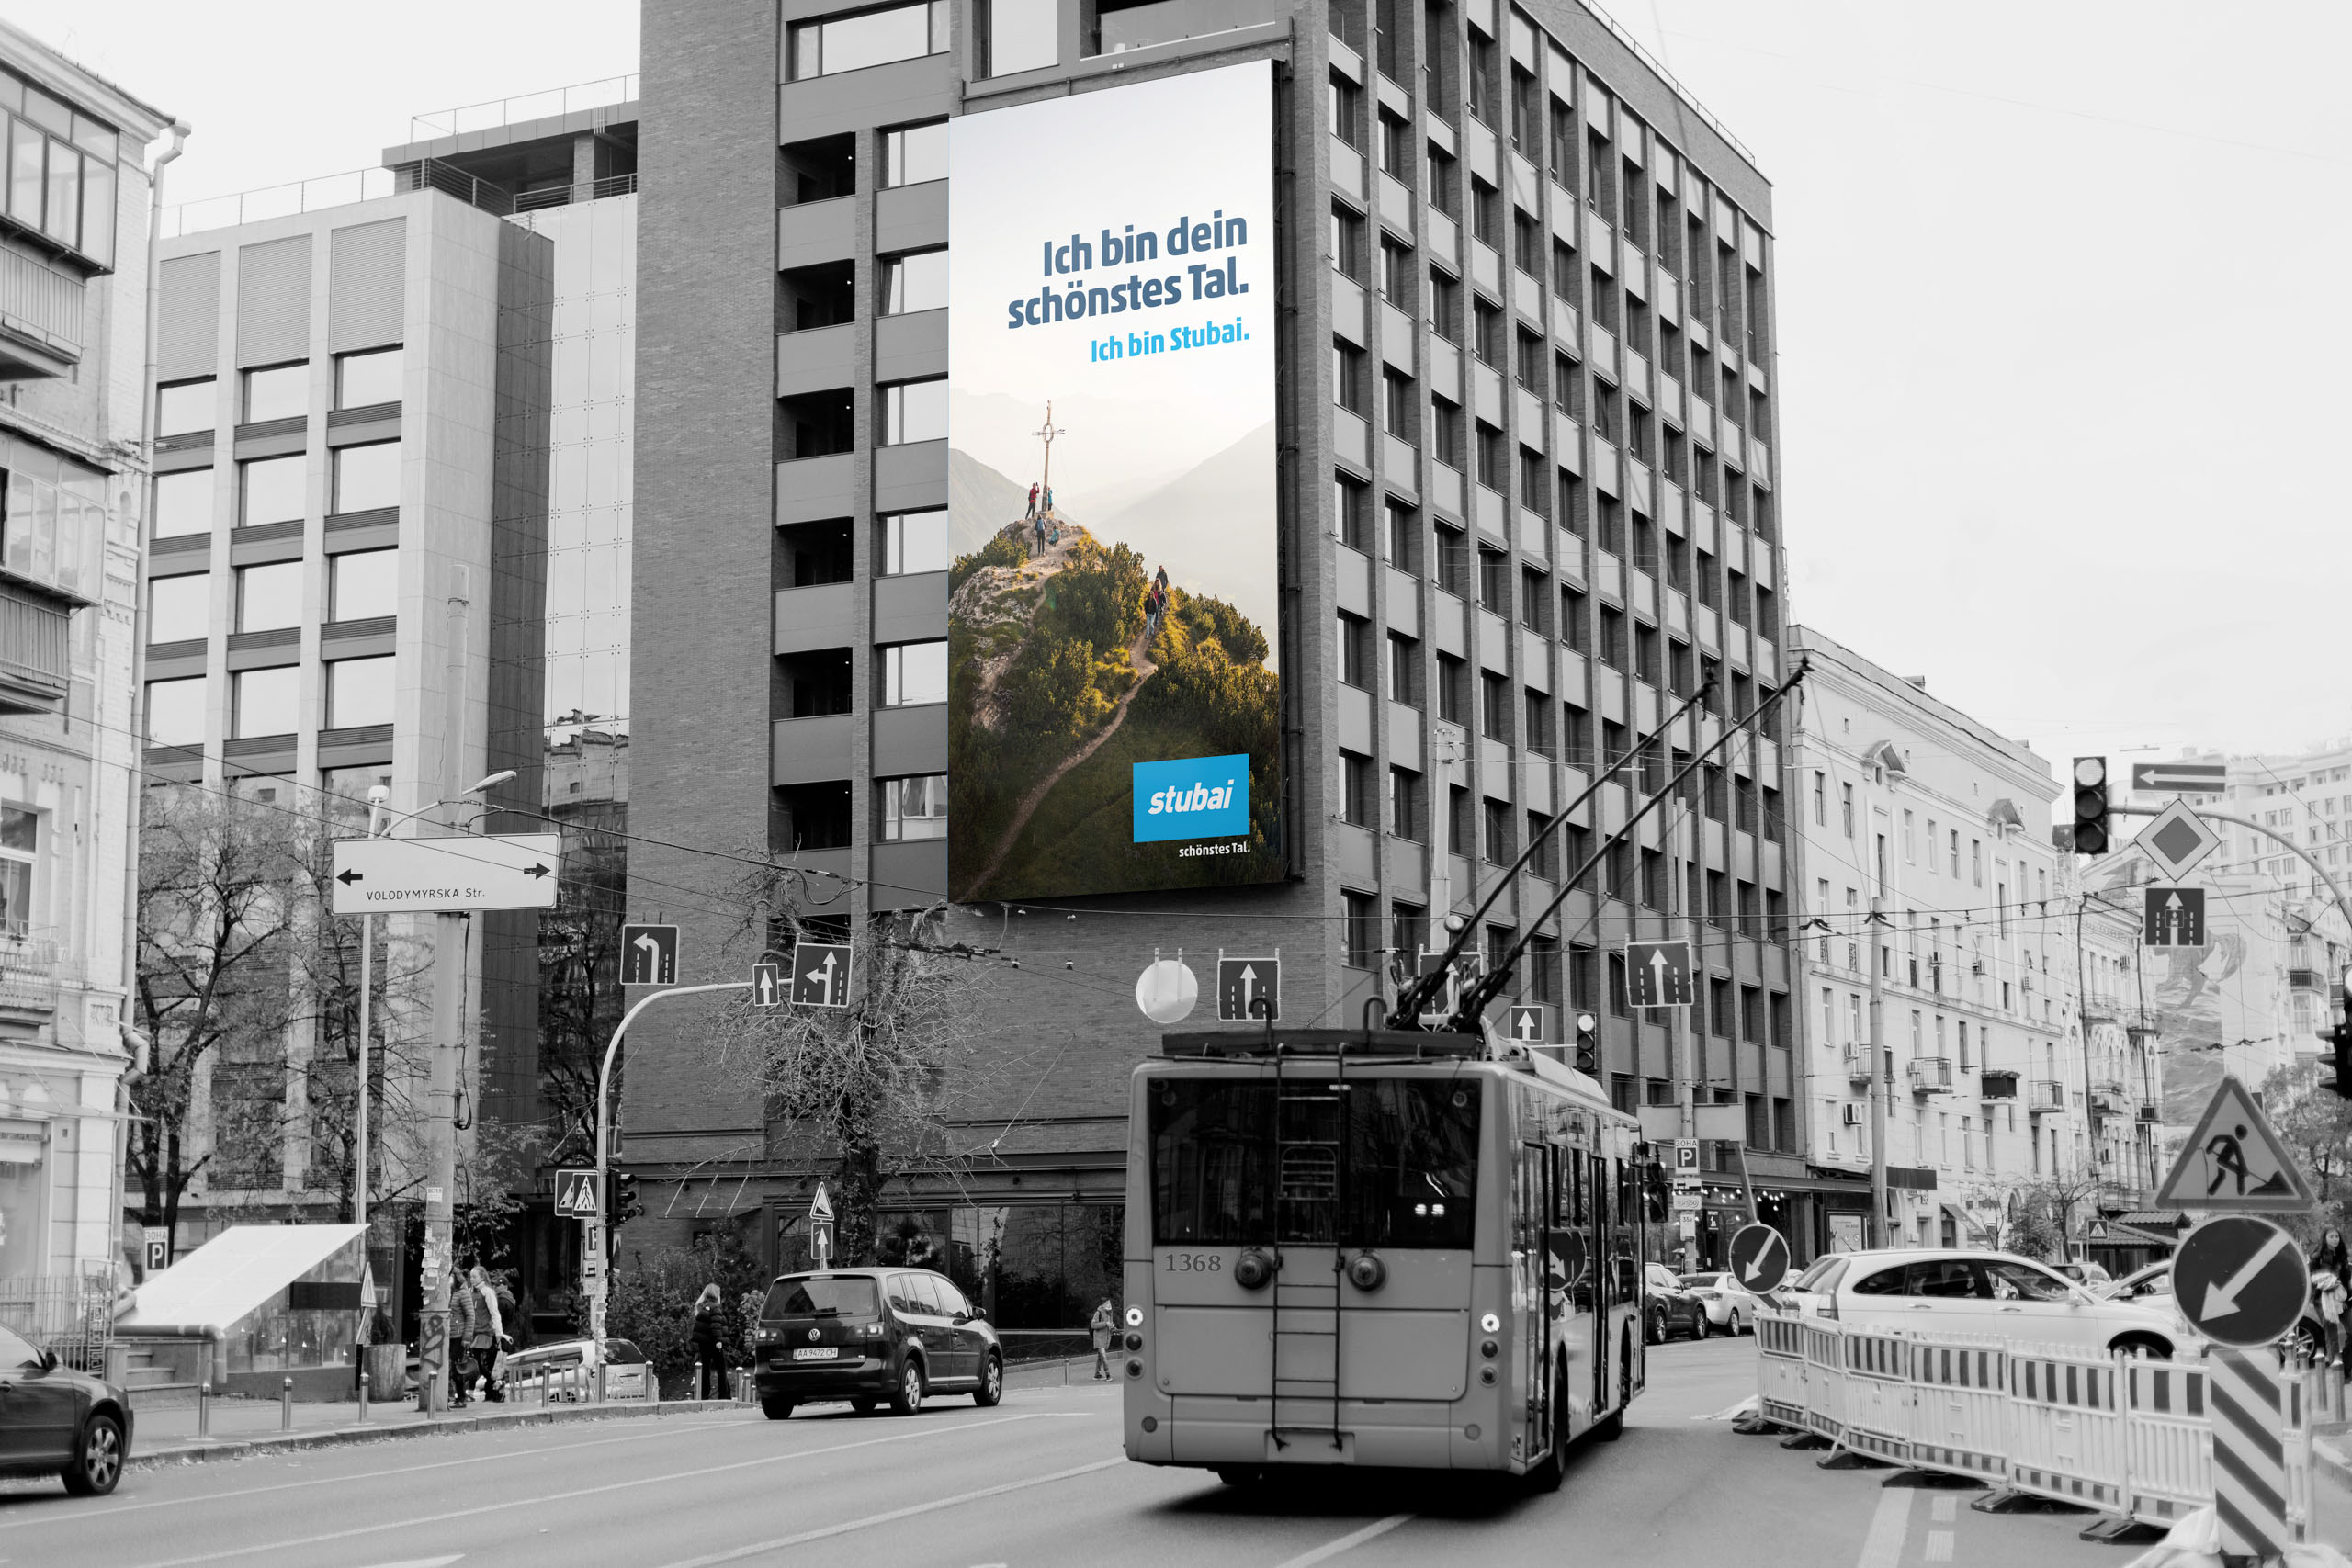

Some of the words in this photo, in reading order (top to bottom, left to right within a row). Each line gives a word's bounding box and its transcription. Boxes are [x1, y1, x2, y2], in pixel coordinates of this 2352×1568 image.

[1044, 234, 1092, 276] Ich
[1102, 224, 1158, 267] bin
[1166, 209, 1248, 256] dein
[1008, 275, 1182, 329] schönstes
[1187, 256, 1250, 301] Tal.
[1091, 335, 1123, 363] Ich
[1128, 330, 1165, 357] bin
[1170, 317, 1250, 352] Stubai.
[1148, 779, 1235, 815] stubai
[1179, 844, 1230, 857] schönstes
[1231, 841, 1250, 853] Tal.
[367, 888, 459, 901] VOLODYMYRSKA
[465, 887, 485, 897] Str.
[1680, 1149, 1693, 1167] P
[152, 1244, 164, 1269] P
[1165, 1253, 1222, 1272] 1368
[797, 1349, 808, 1358] AA
[808, 1348, 825, 1357] 9472
